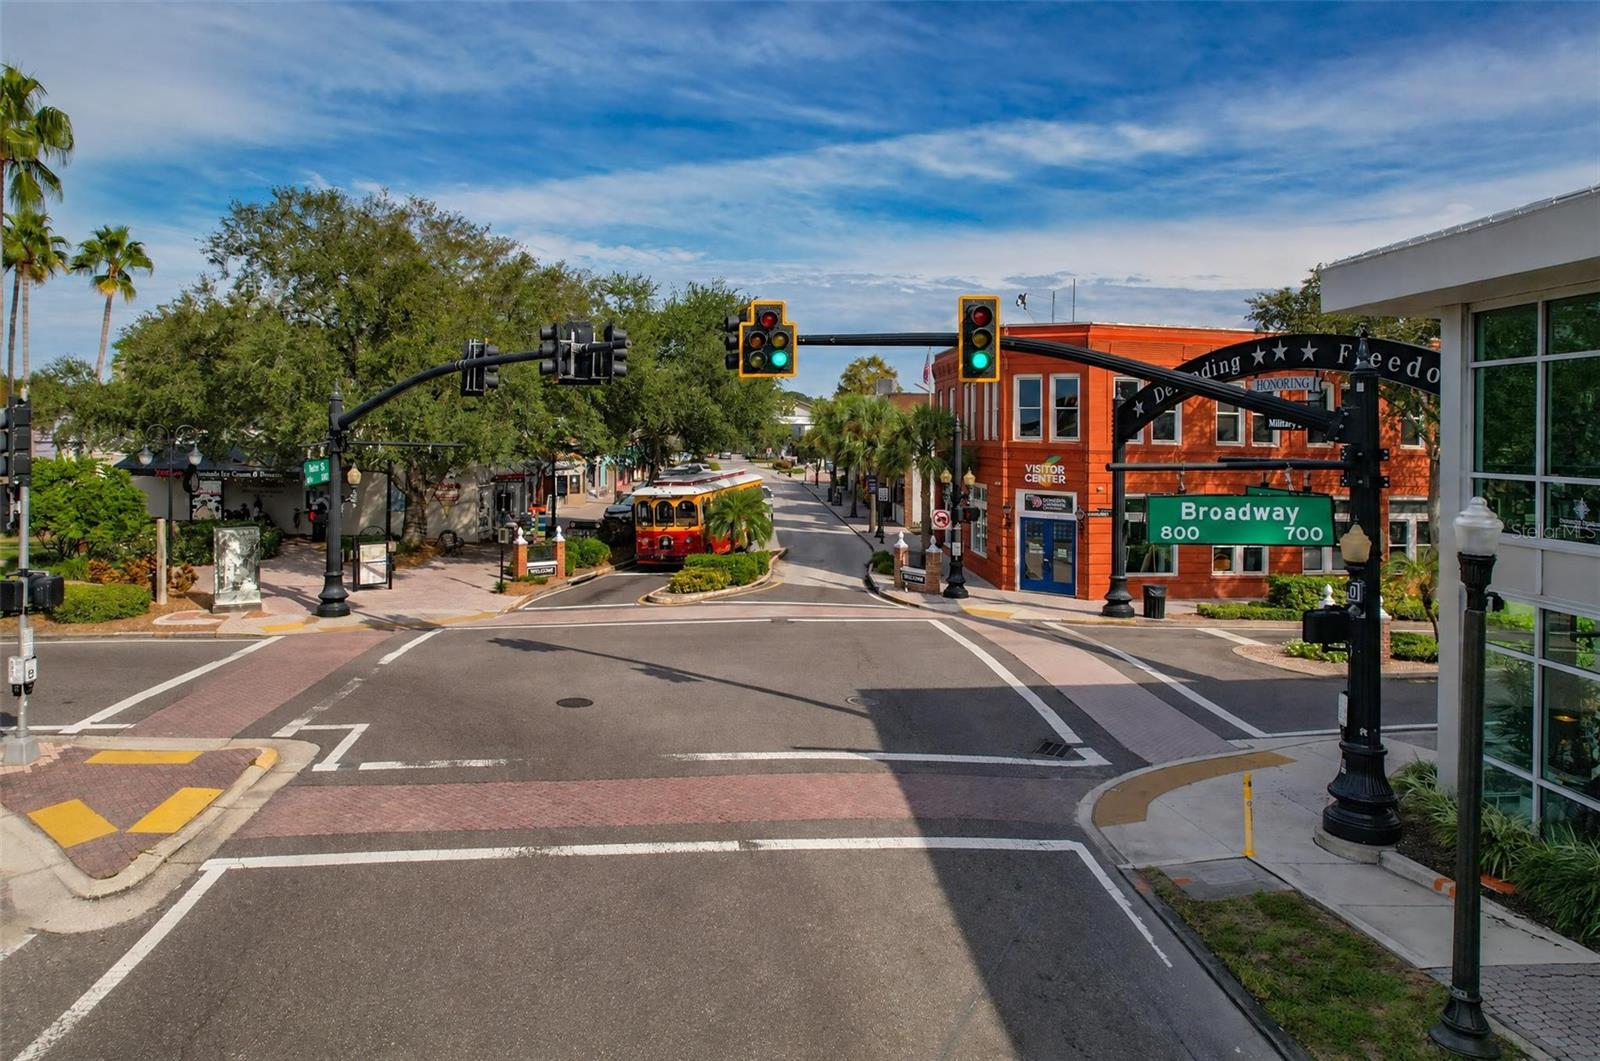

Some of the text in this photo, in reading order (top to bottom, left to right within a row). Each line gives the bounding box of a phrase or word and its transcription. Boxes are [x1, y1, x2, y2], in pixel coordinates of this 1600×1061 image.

[1336, 343, 1440, 384] Feedo
[1256, 377, 1310, 391] HONORING
[1268, 418, 1296, 429] Military
[1025, 463, 1065, 475] VISITOR
[1024, 473, 1066, 484] CENTER
[1181, 501, 1300, 526] Broadway
[1160, 526, 1324, 541] 800 700
